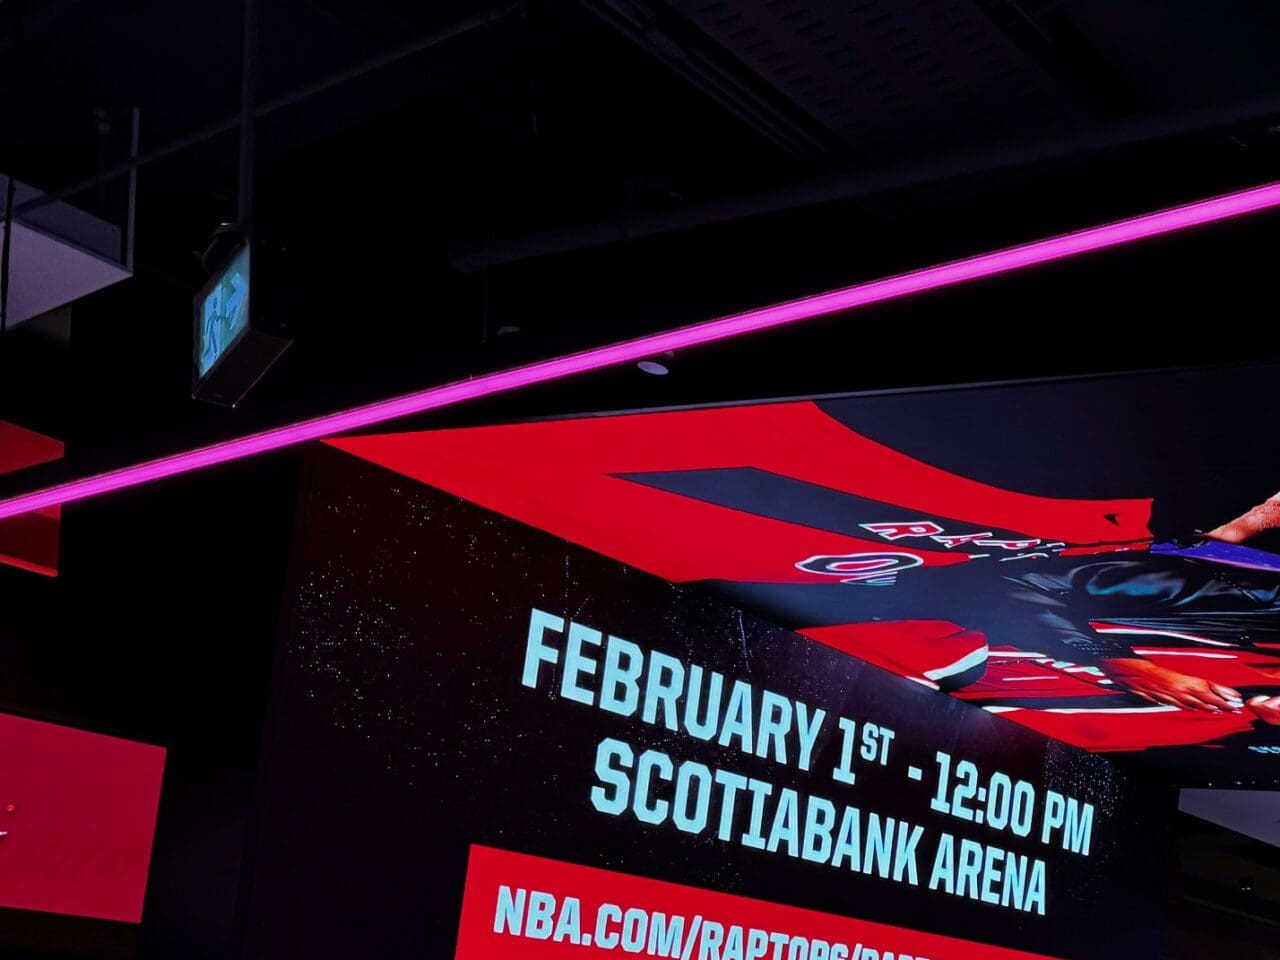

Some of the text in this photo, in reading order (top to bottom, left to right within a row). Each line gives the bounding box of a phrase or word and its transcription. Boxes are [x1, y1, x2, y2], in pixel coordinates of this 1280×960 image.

[520, 607, 826, 772] FEBRUARY
[833, 717, 896, 787] 1ST
[930, 750, 1034, 839] 12:00
[1041, 789, 1095, 858] PM
[590, 737, 1048, 916] SCOTIABANK ARENA
